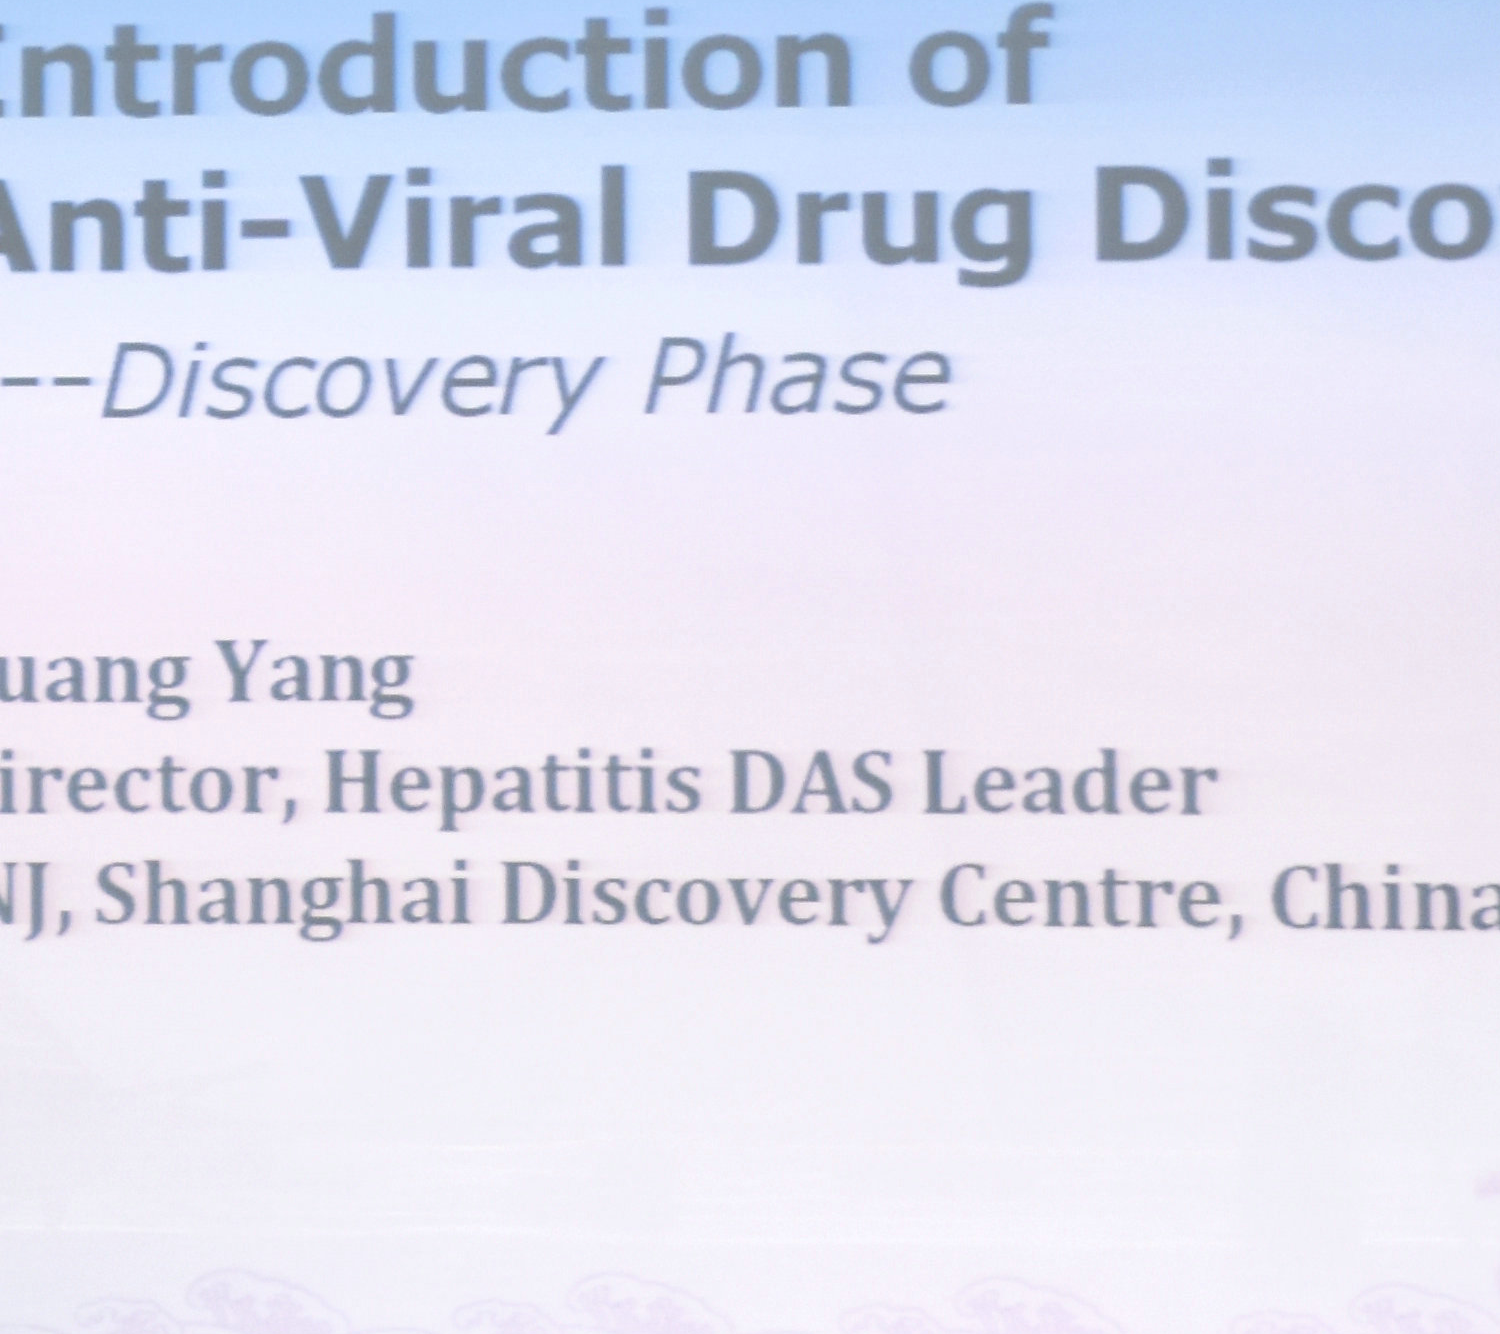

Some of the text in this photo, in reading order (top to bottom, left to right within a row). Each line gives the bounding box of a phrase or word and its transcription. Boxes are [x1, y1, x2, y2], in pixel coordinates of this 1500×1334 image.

[907, 1, 1055, 108] of
[687, 167, 1036, 290] Drug
[642, 331, 954, 417] Phase
[213, 638, 417, 722] Yang
[324, 746, 704, 833] Hepatitis
[728, 747, 895, 816] DAS
[922, 747, 1222, 817] Leader
[94, 857, 474, 945] Shanghai
[500, 858, 916, 947] Discovery
[938, 862, 1246, 942] Centre,
